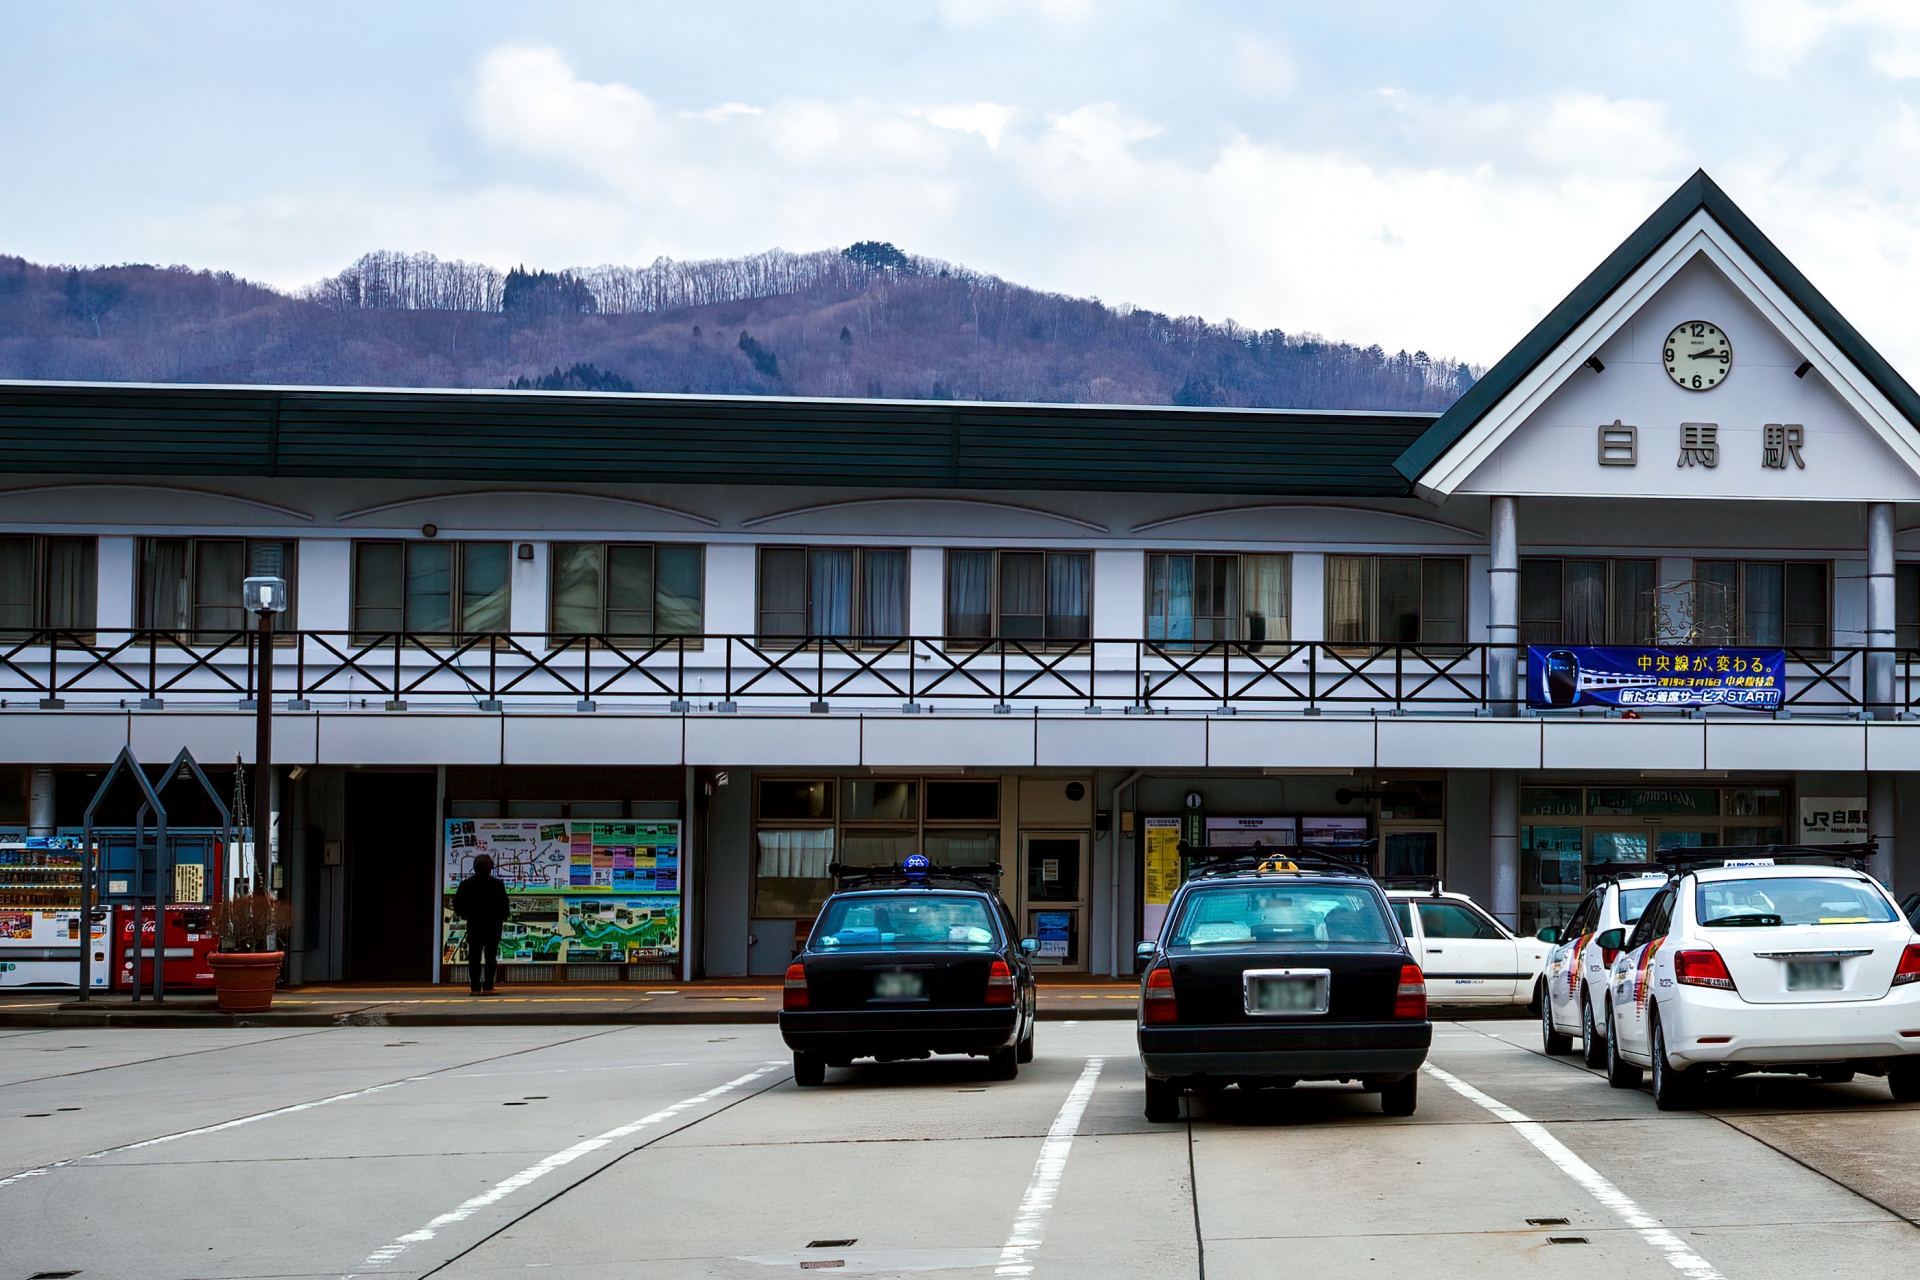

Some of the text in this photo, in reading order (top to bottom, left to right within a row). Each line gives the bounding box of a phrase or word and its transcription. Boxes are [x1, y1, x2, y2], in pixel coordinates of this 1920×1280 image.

[1689, 323, 1705, 338] 12
[1664, 348, 1675, 363] 9
[1719, 350, 1730, 364] 3
[1691, 374, 1703, 389] 6
[1597, 419, 1806, 470] 白馬駅
[1637, 654, 1772, 673] 中央線が、変わる。
[1803, 812, 1829, 827] JR
